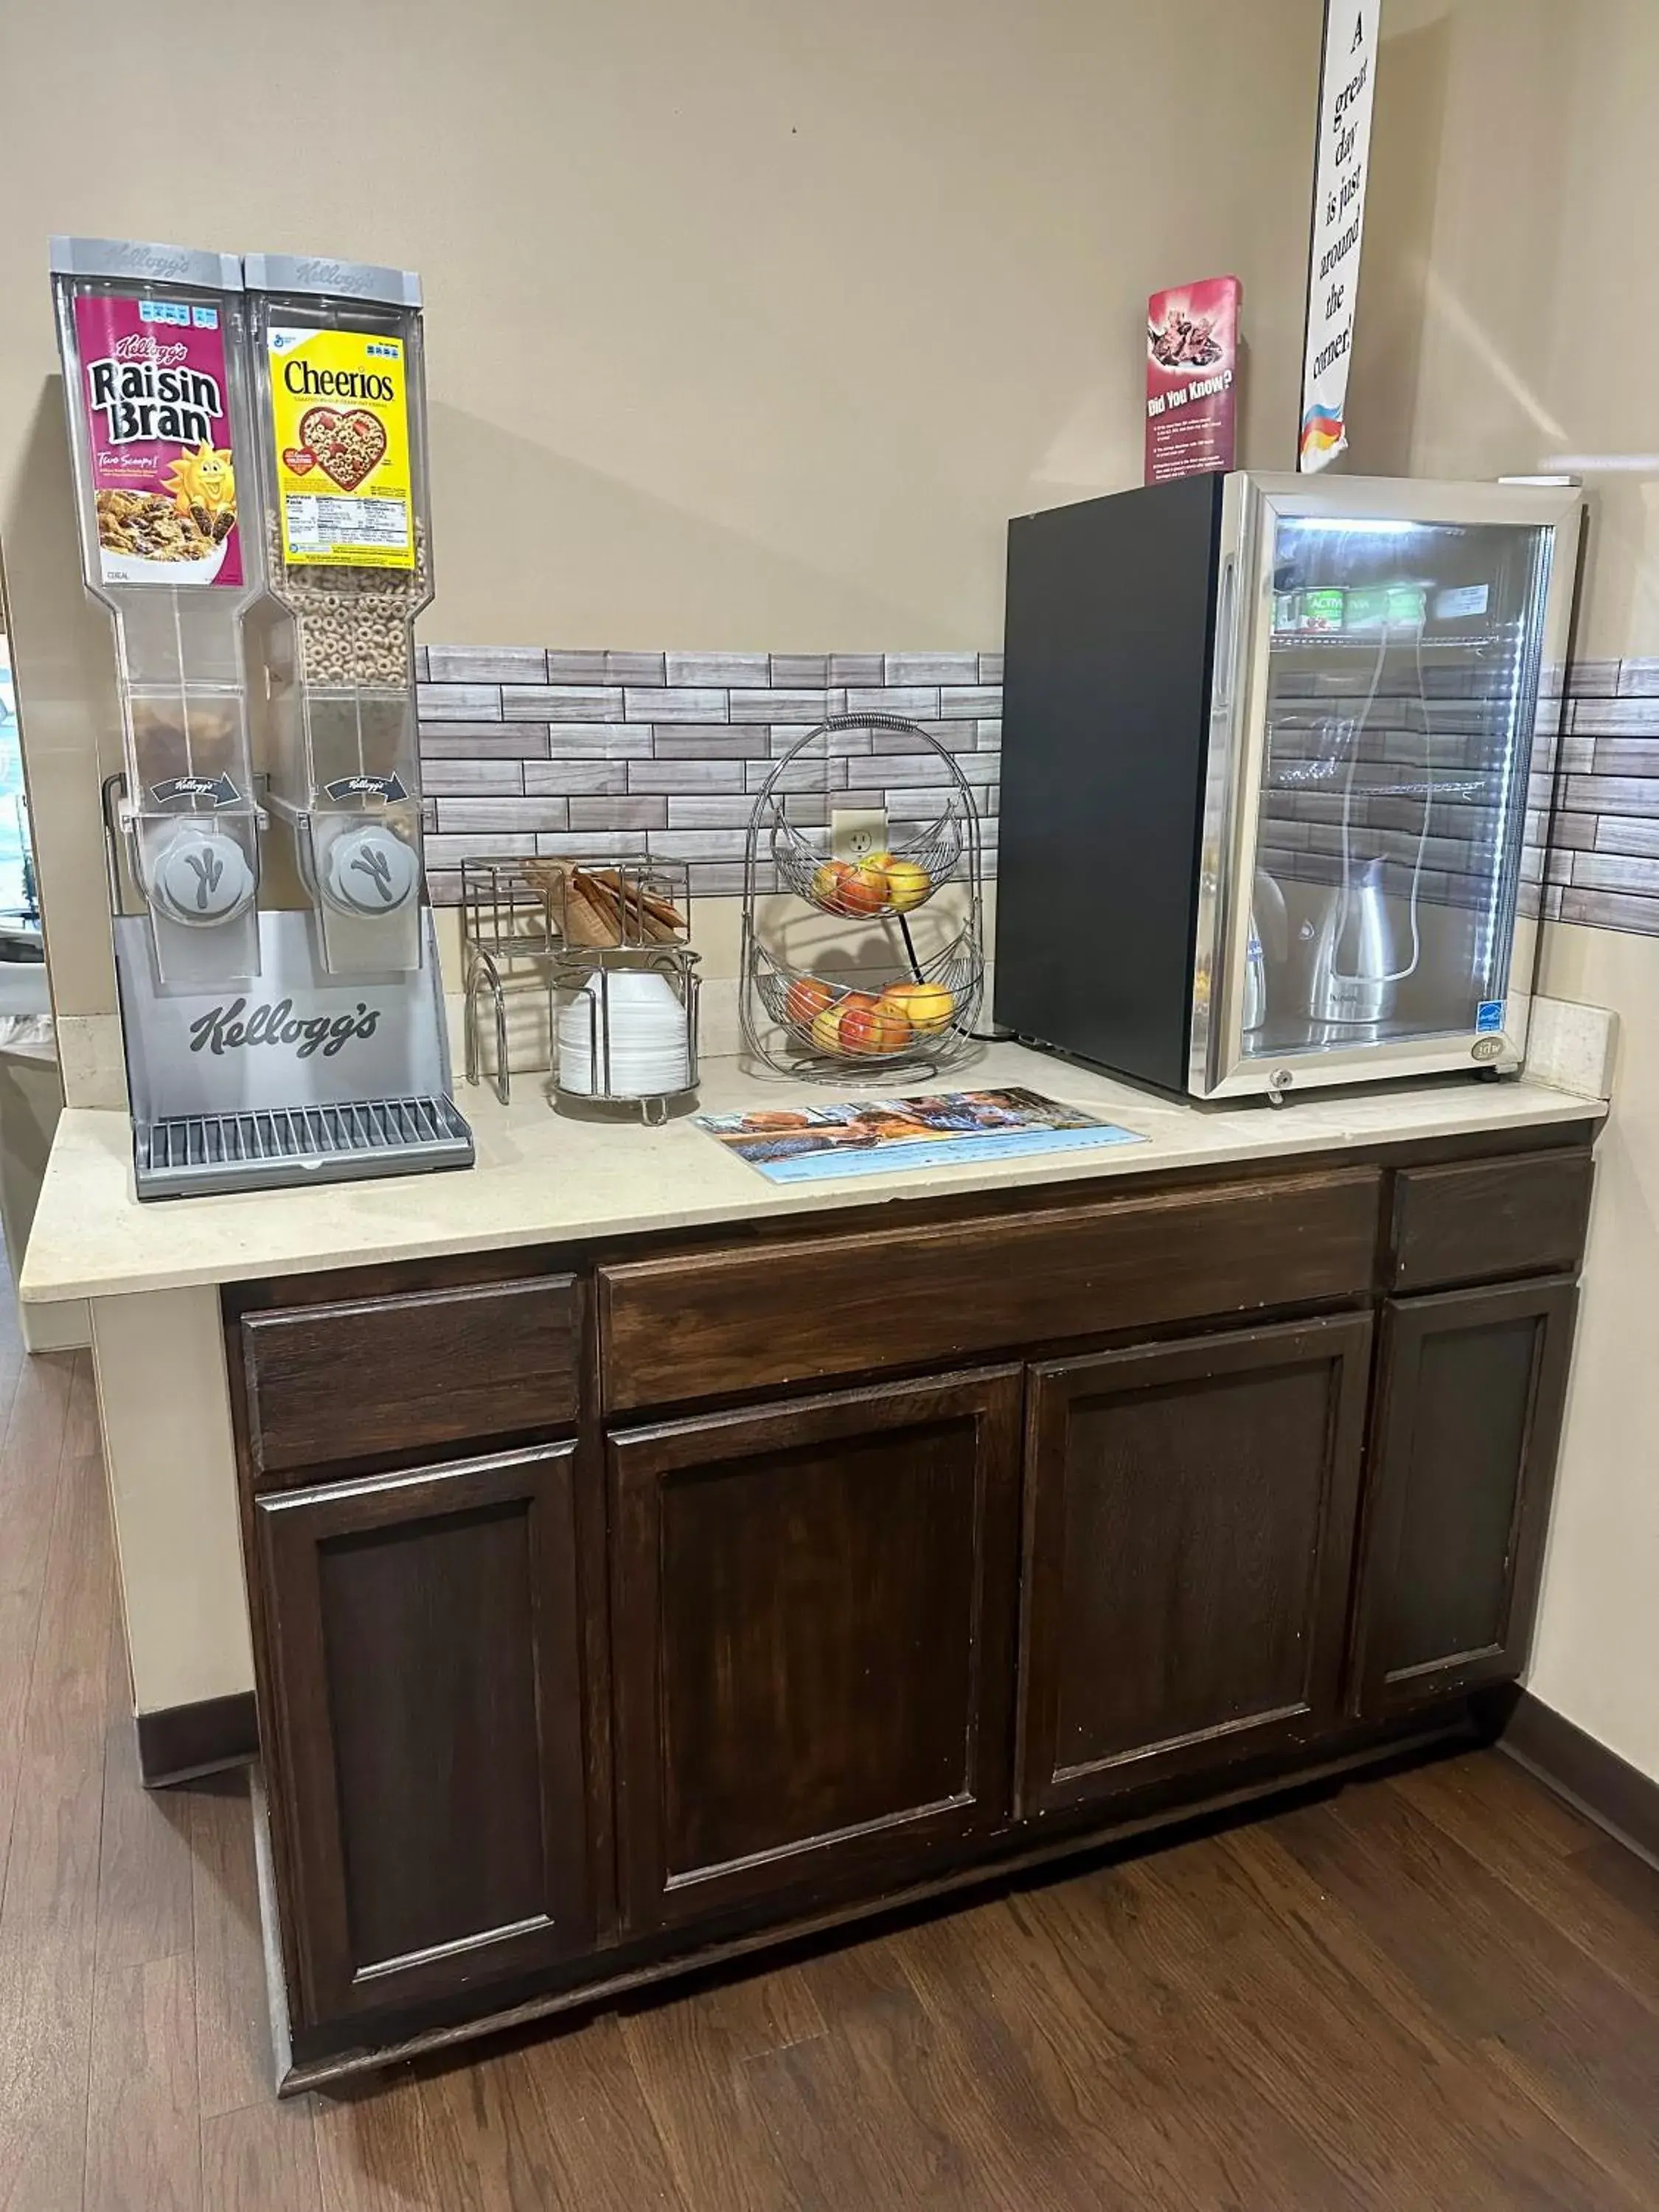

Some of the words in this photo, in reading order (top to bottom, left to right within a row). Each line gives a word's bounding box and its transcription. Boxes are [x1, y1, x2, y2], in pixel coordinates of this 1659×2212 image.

[1349, 11, 1363, 54] A
[1333, 58, 1368, 133] great
[1335, 120, 1358, 167] day
[1325, 191, 1336, 226] is
[1338, 164, 1361, 224] just
[1319, 203, 1360, 280] around
[296, 260, 375, 294] Kellogg's
[1325, 283, 1344, 320] the
[116, 335, 188, 364] Kellogg's
[1313, 313, 1352, 379] corner!
[89, 361, 221, 415] Raisin
[284, 360, 394, 402] Cheerios
[1147, 395, 1166, 417] Did
[1166, 388, 1188, 409] You
[1188, 369, 1233, 400] Know?
[111, 400, 215, 445] Bran
[97, 451, 119, 467] Two
[121, 454, 159, 468] Scoops!
[175, 779, 213, 793] Kellogg's
[348, 778, 384, 791] Kellogg's
[189, 998, 381, 1059] Kellogg's
